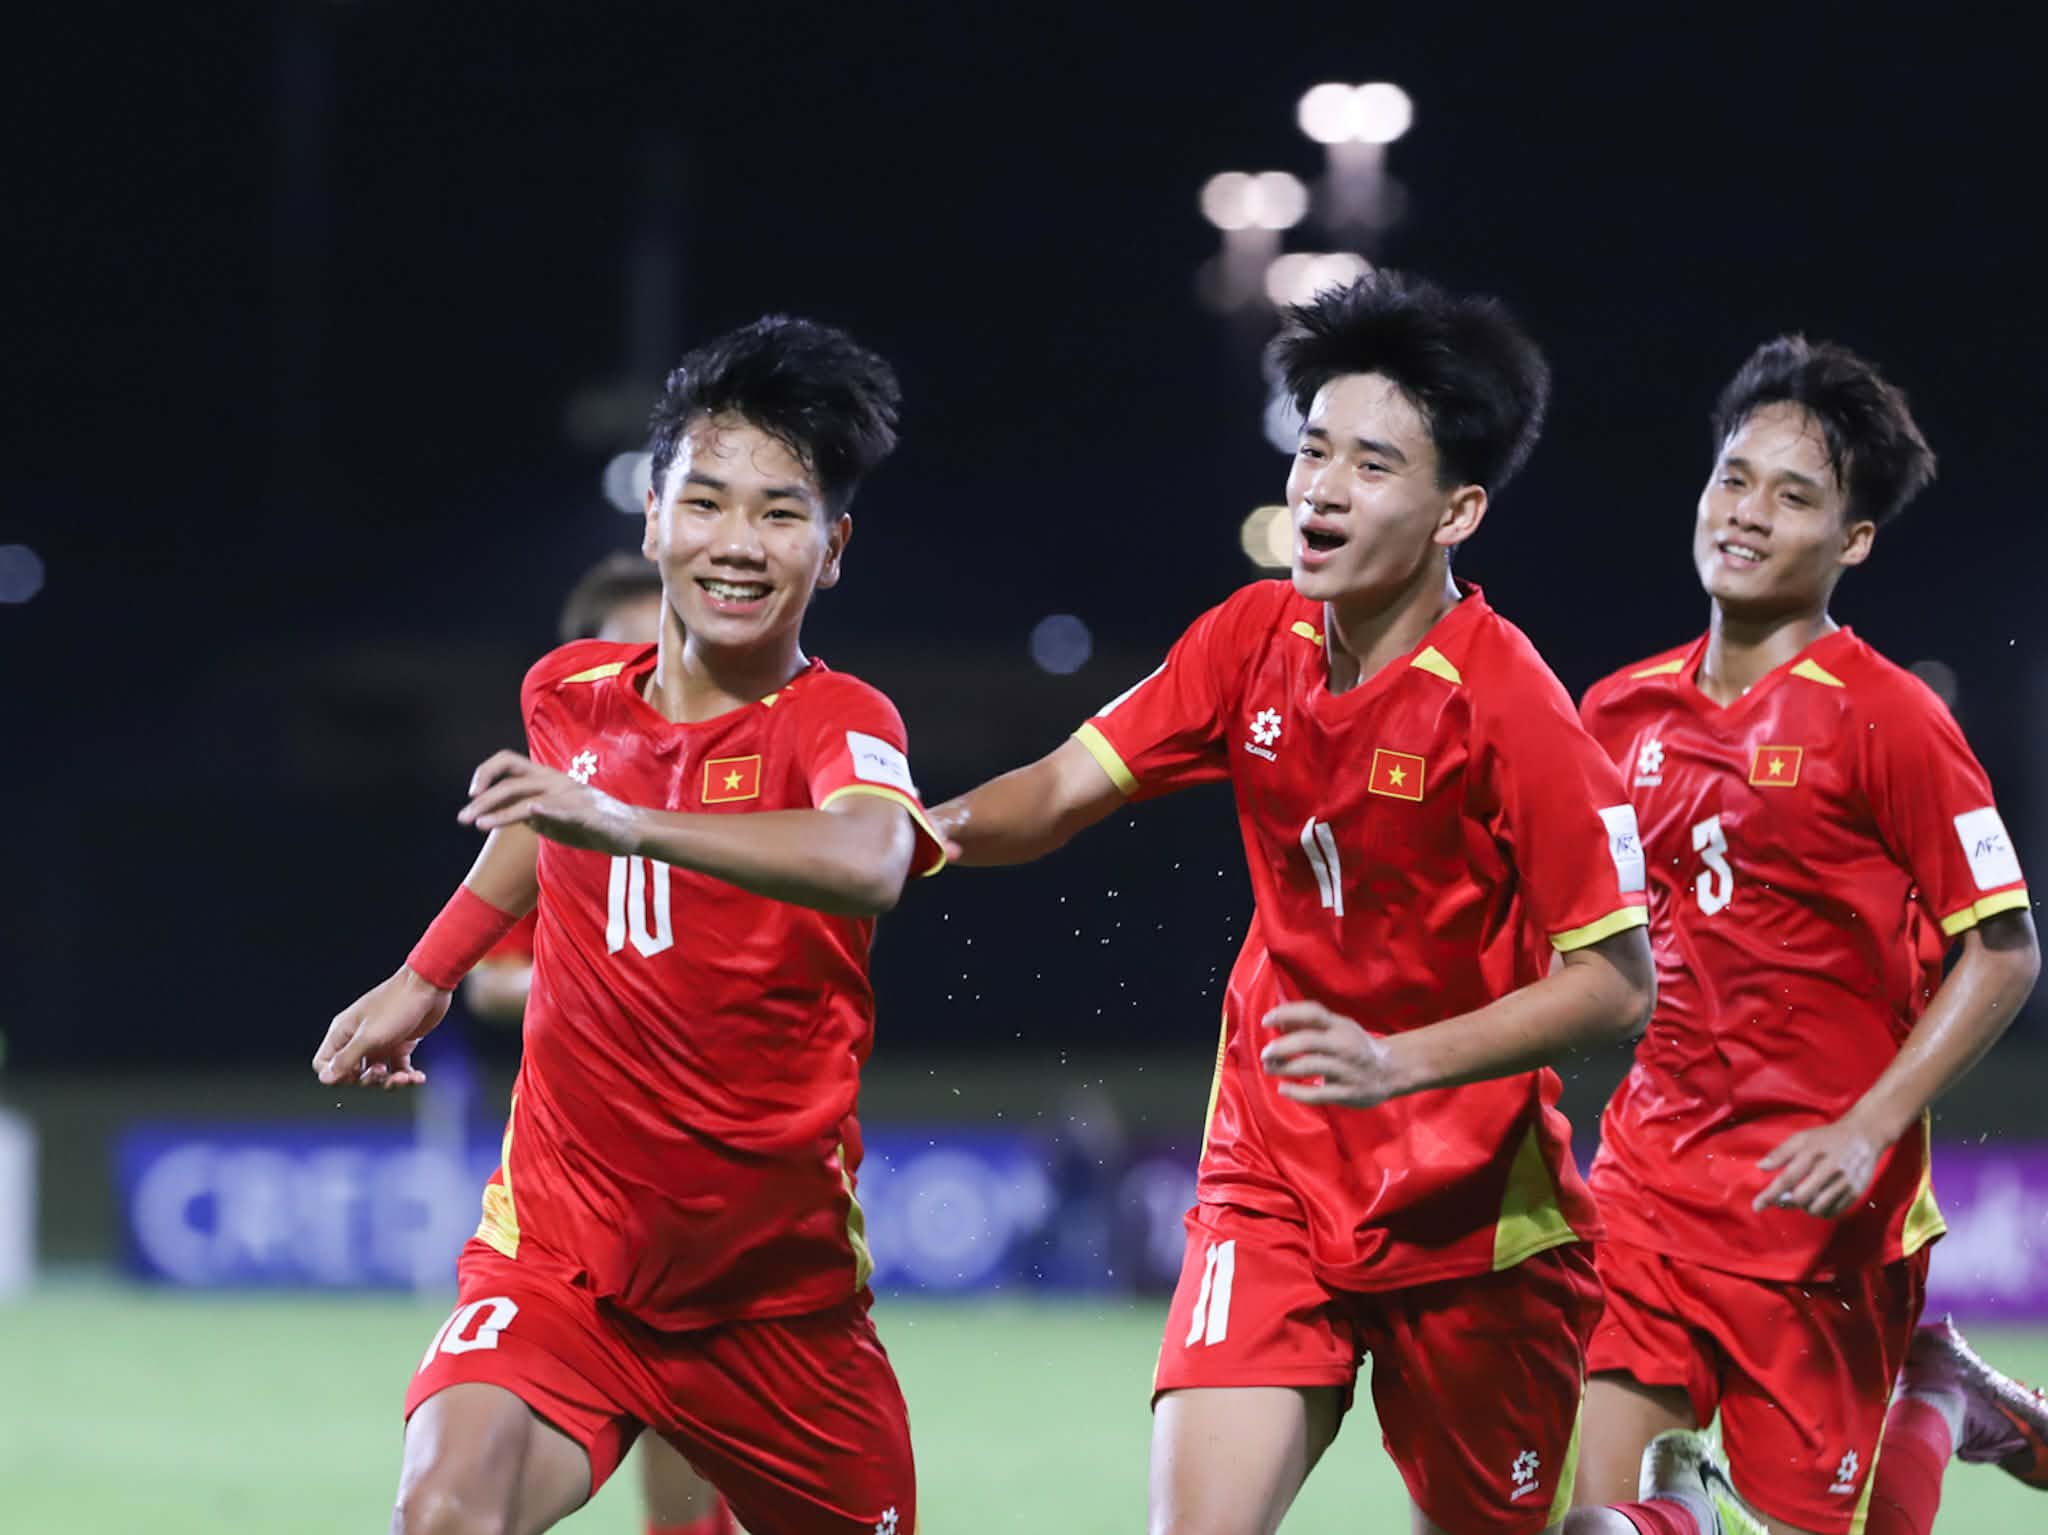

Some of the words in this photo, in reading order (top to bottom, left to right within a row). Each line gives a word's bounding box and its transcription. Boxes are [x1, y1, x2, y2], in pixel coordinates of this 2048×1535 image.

[606, 855, 674, 958] 10
[1300, 816, 1344, 917] 11
[1692, 815, 1734, 916] 3
[418, 1296, 518, 1374] 10
[1186, 1240, 1236, 1348] 11
